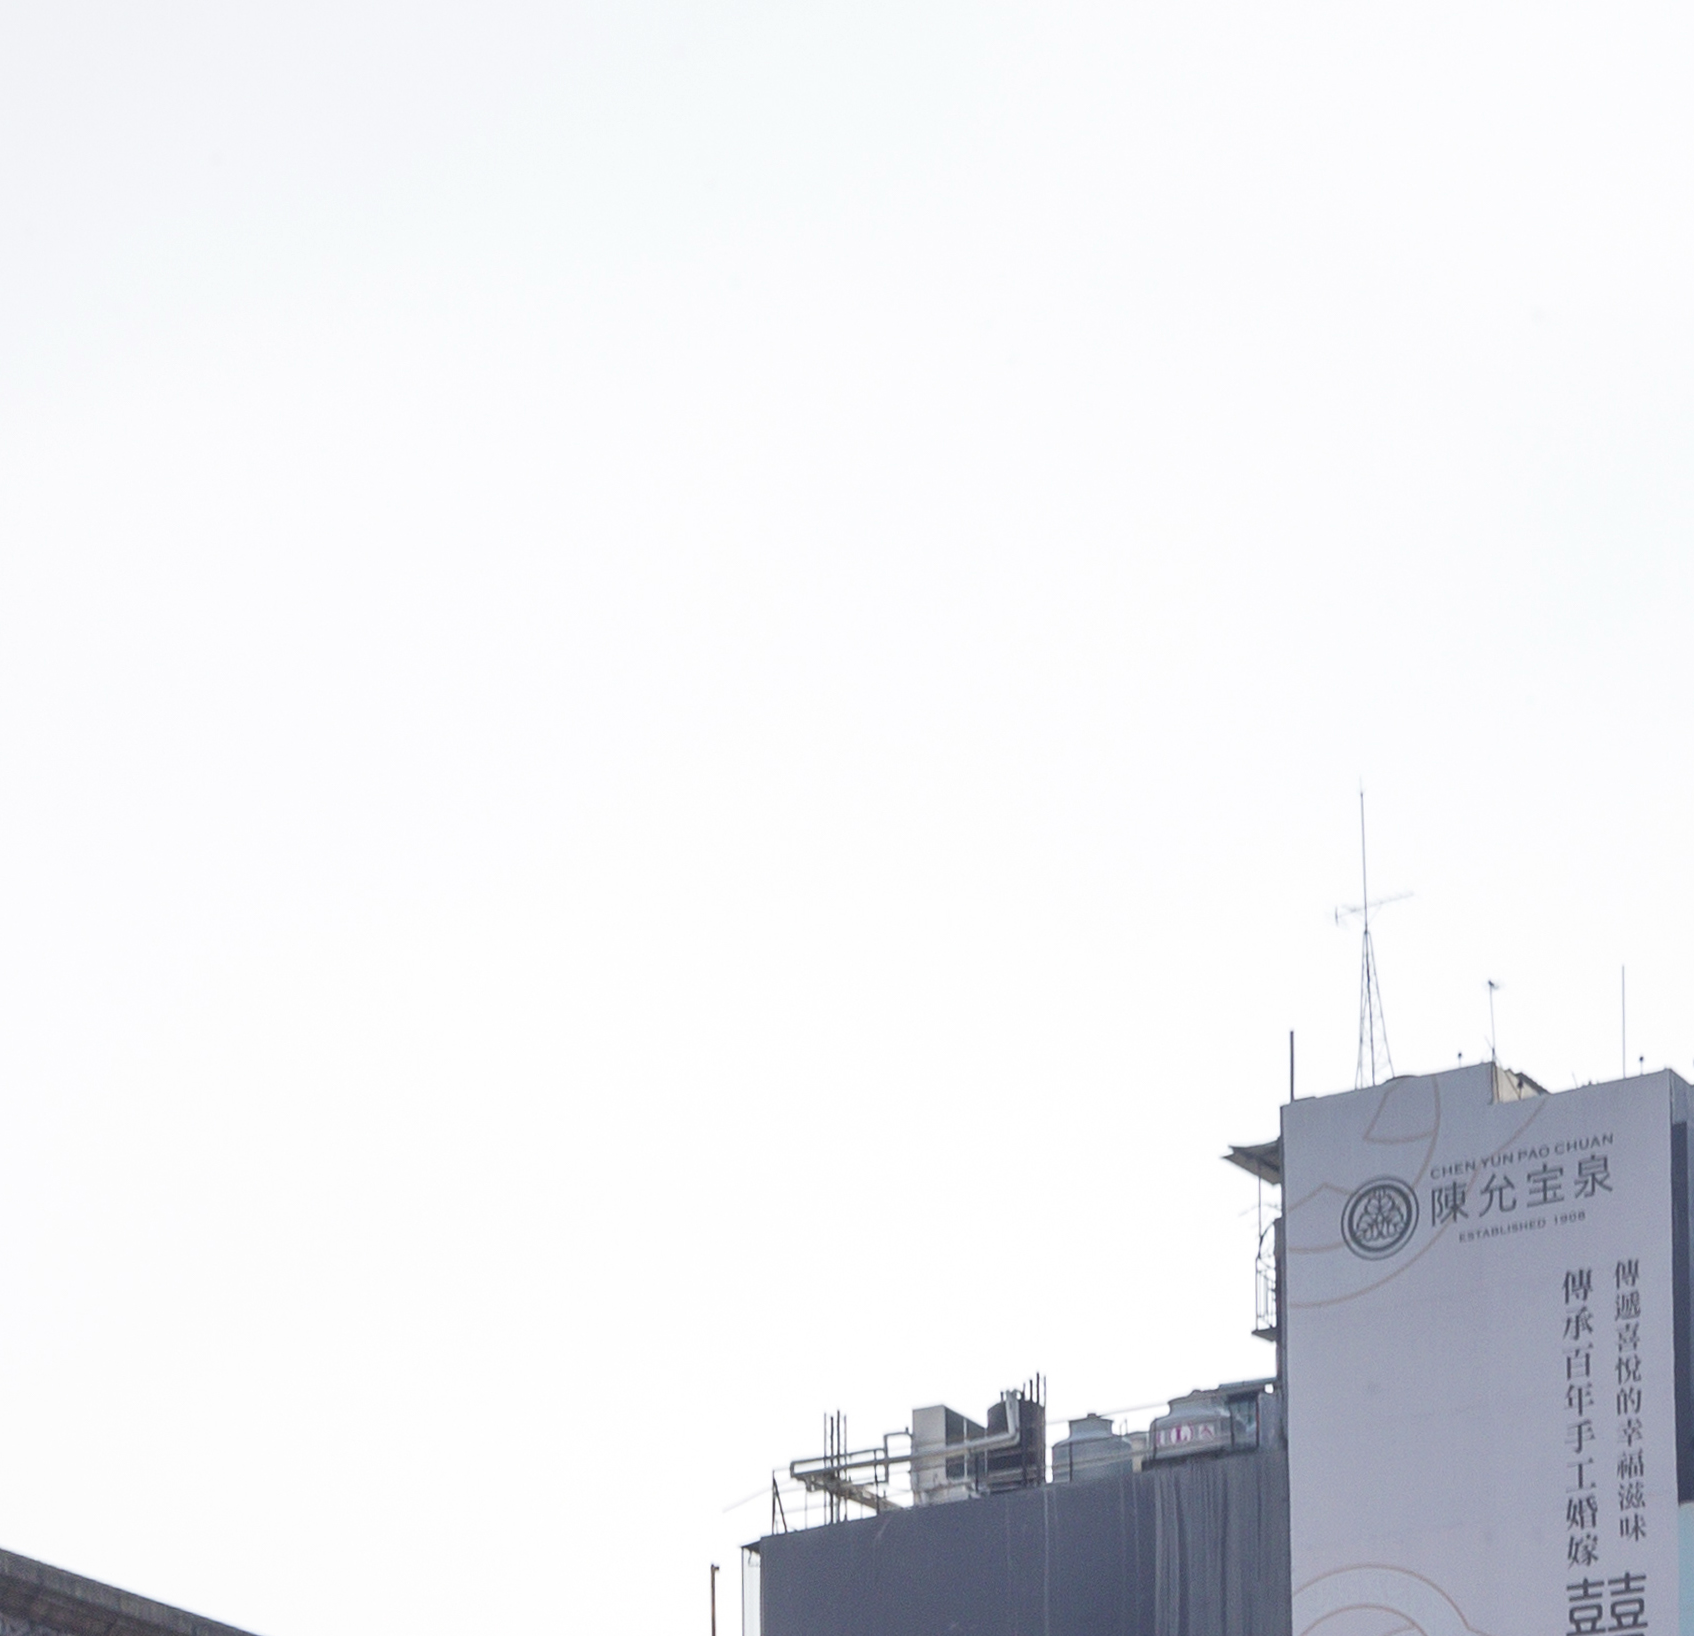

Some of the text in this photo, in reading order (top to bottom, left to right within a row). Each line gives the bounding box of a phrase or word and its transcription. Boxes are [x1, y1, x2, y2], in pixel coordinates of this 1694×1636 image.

[1430, 1133, 1614, 1180] CHEN YUN PAO CHUAN
[1431, 1153, 1613, 1228] 陳允宝泉
[1458, 1211, 1586, 1243] ESTABLISHED 1908
[1563, 1267, 1599, 1569] 傳承百年手工婚嫁
[1615, 1258, 1646, 1542] 傳遞喜悅的幸福滋味
